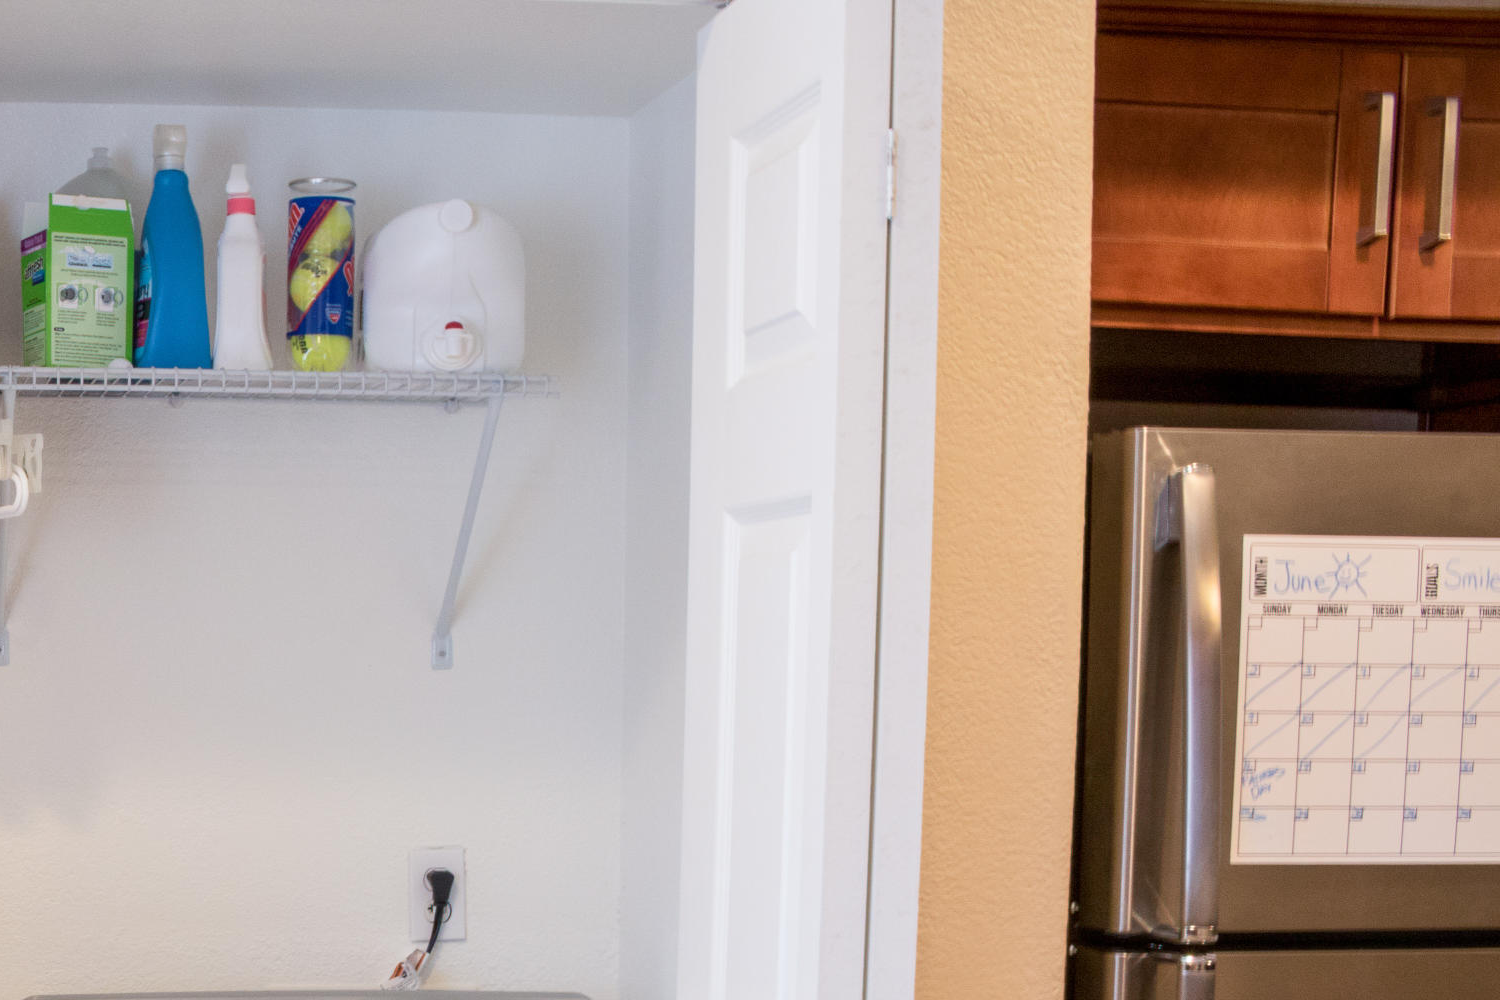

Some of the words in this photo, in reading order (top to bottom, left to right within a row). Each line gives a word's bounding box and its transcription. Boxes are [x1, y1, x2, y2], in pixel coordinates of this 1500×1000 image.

[1274, 559, 1330, 595] June
[1262, 603, 1292, 616] SUNDAY
[1317, 604, 1348, 616] MONDAY
[1372, 605, 1404, 617] TUESDAY
[1420, 606, 1465, 618] WEDNESDAY
